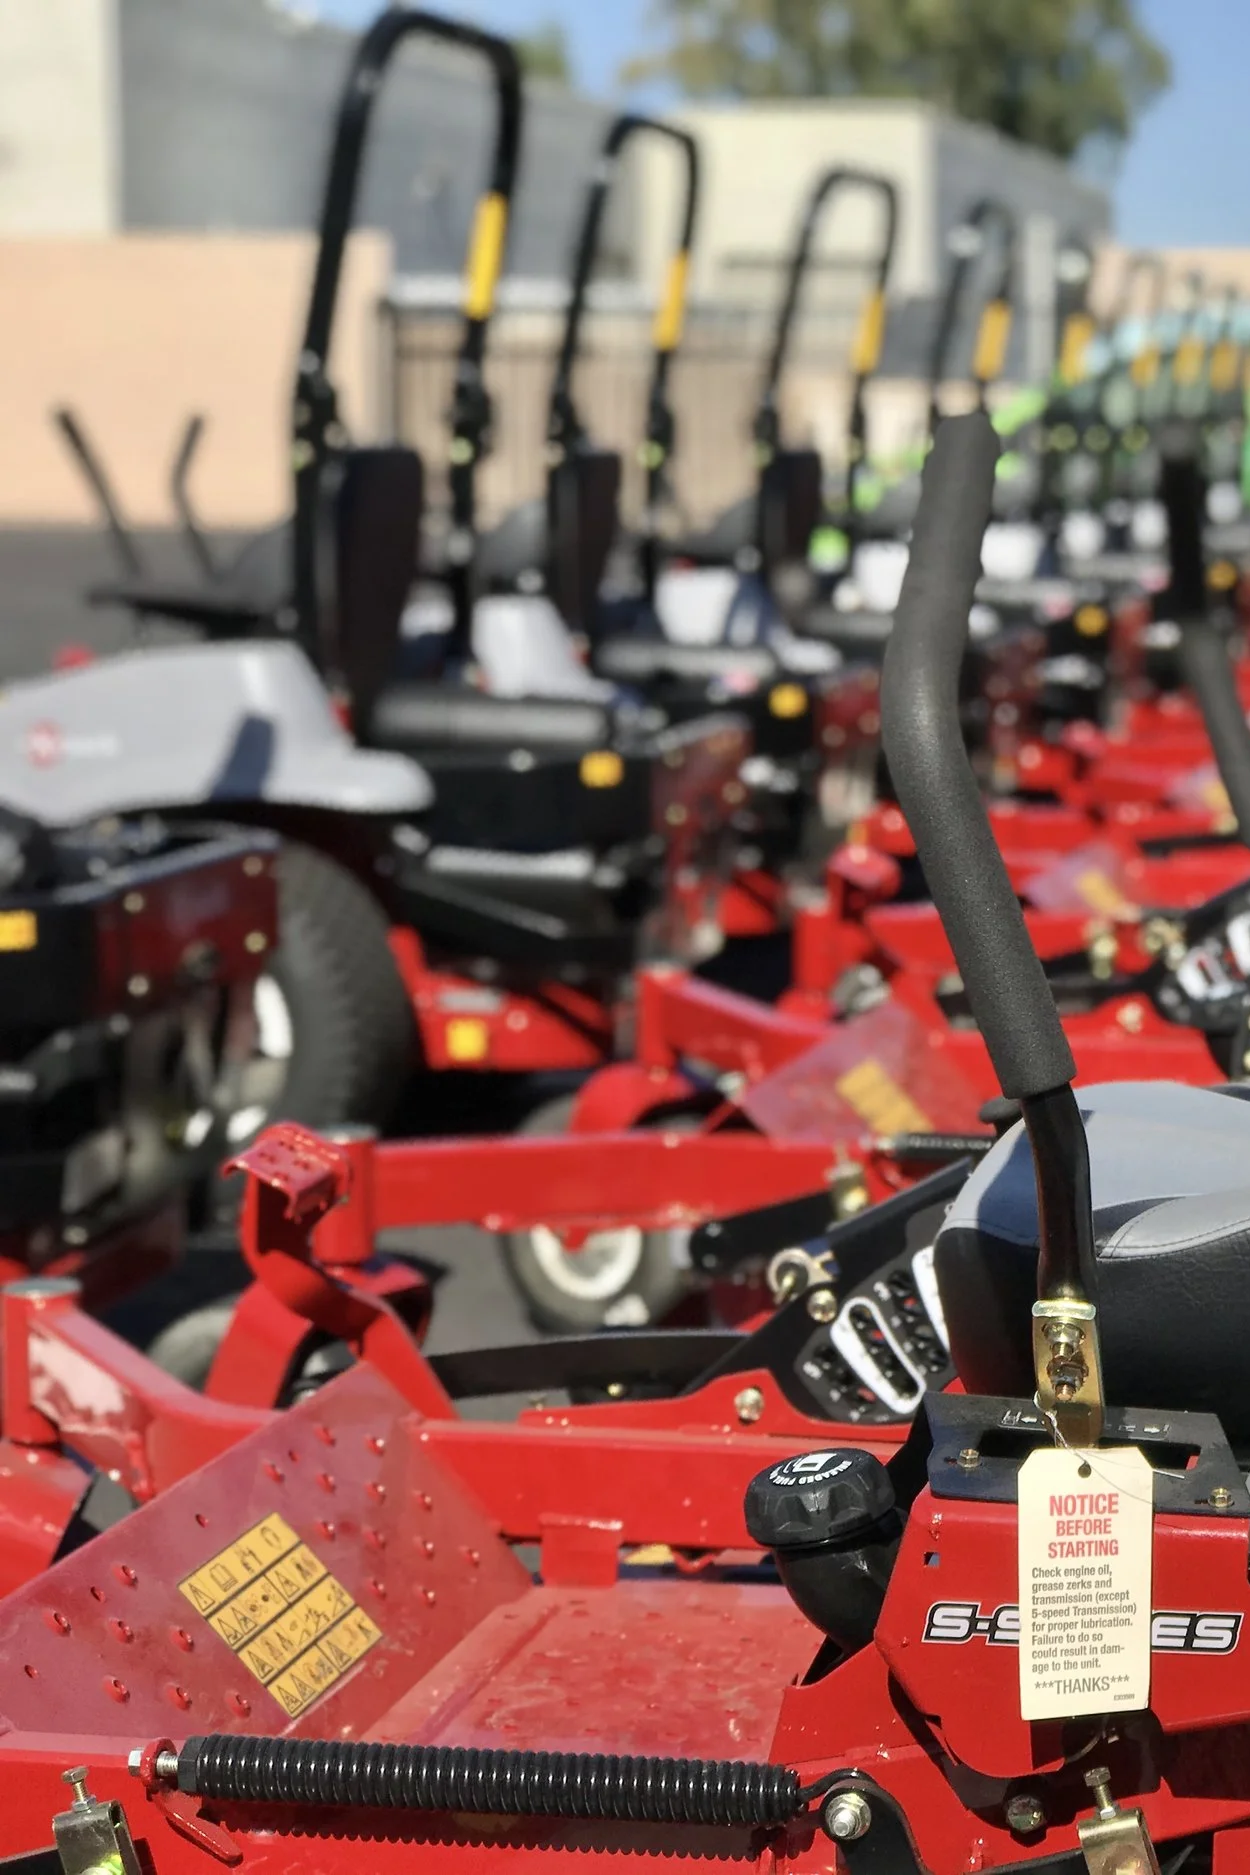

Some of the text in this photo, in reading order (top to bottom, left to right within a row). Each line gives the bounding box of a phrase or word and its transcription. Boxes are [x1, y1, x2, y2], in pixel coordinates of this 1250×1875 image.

[1049, 1493, 1119, 1516] NOTICE
[1056, 1518, 1112, 1537] BEFORE
[1048, 1539, 1119, 1559] STARTING
[1032, 1564, 1112, 1578] Check engine oil,
[1032, 1577, 1112, 1594] grease zerks and
[1032, 1590, 1130, 1605] transmission (except
[1032, 1603, 1137, 1620] 5-speed Transmission)
[924, 1603, 1242, 1653] S-SES
[1032, 1617, 1133, 1633] for proper lubrication.
[1032, 1632, 1103, 1646] Failure to do so
[1032, 1644, 1125, 1659] could result in dam-
[1032, 1658, 1101, 1674] age to the unit.
